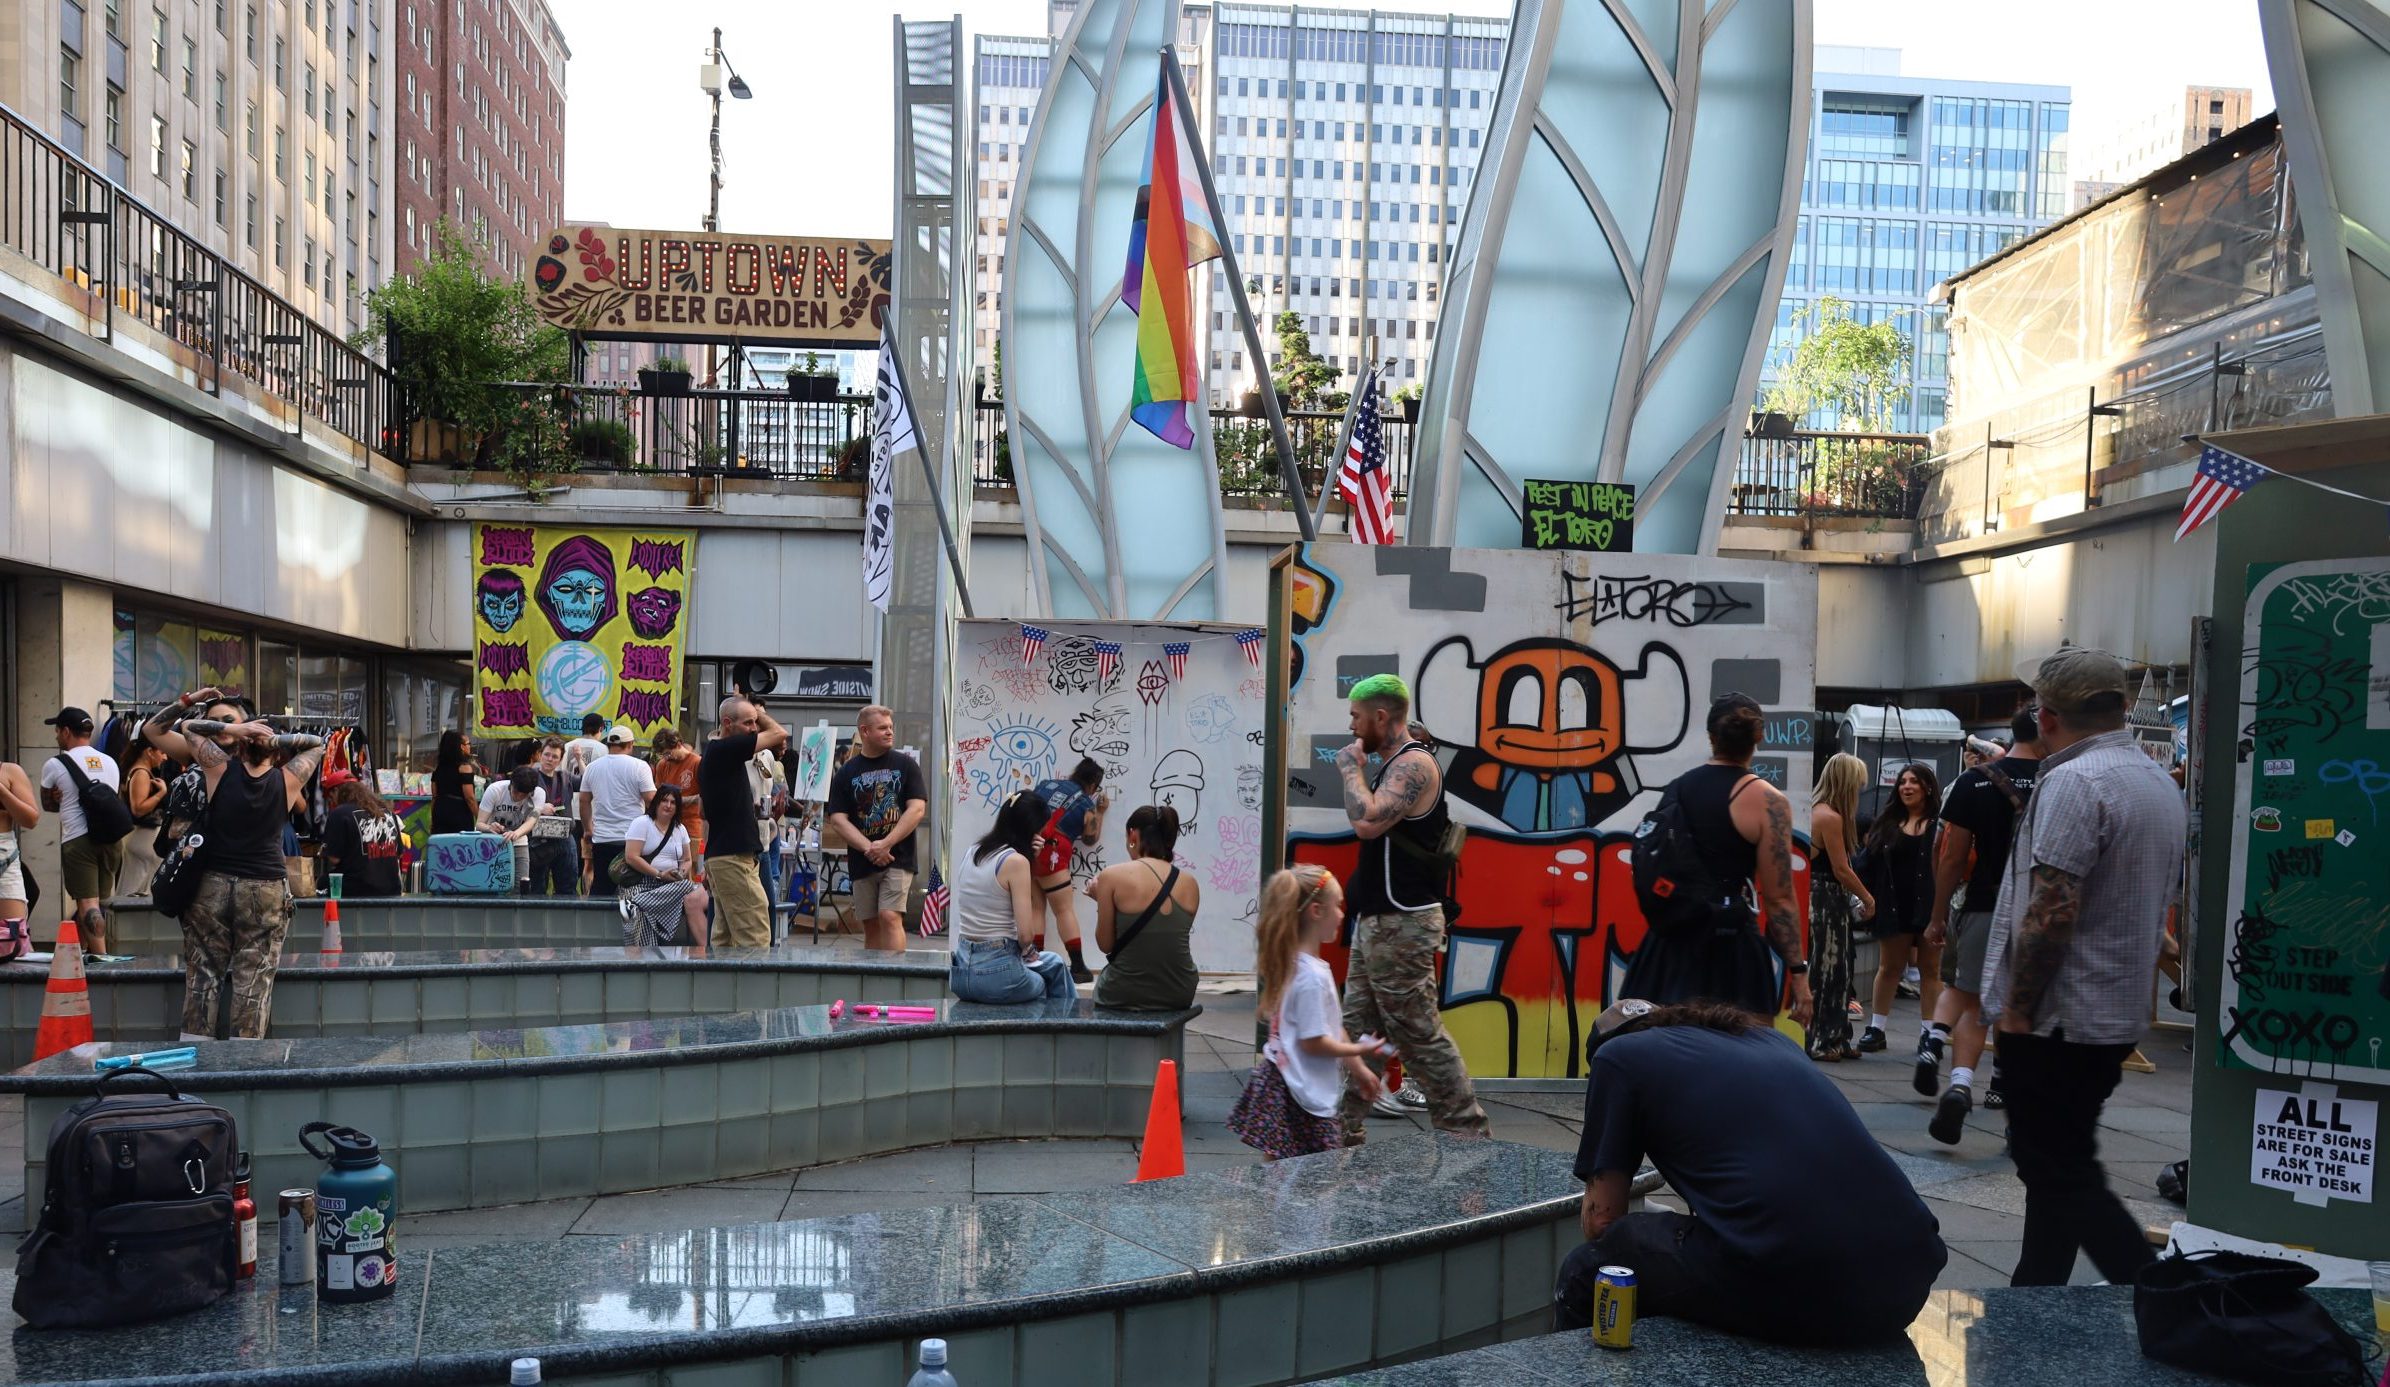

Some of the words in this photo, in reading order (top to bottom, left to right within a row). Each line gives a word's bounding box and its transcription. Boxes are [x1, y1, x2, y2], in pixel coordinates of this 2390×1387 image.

[618, 237, 848, 298] UPTOWN
[634, 294, 706, 324] BEER
[714, 297, 828, 328] GARDEN
[1524, 481, 1570, 507] REST
[1571, 483, 1589, 512] IN
[1592, 484, 1634, 520] PEACE
[1530, 509, 1560, 548] EL
[1553, 511, 1614, 550] TORO
[2156, 743, 2172, 759] WAY
[2287, 947, 2339, 969] STEP
[2266, 970, 2354, 995] OUTSIDE
[2223, 1006, 2358, 1050] XOXO
[2277, 1096, 2352, 1133] ALL
[2257, 1123, 2317, 1143] STREET
[2322, 1133, 2372, 1151] SIGNS
[2256, 1138, 2287, 1153] ARE
[2293, 1143, 2323, 1159] FOR
[2329, 1148, 2371, 1166] SALE
[2277, 1156, 2309, 1171] ASK
[2315, 1161, 2346, 1177] THE
[2261, 1167, 2313, 1186] FRONT
[2319, 1176, 2361, 1195] DESK
